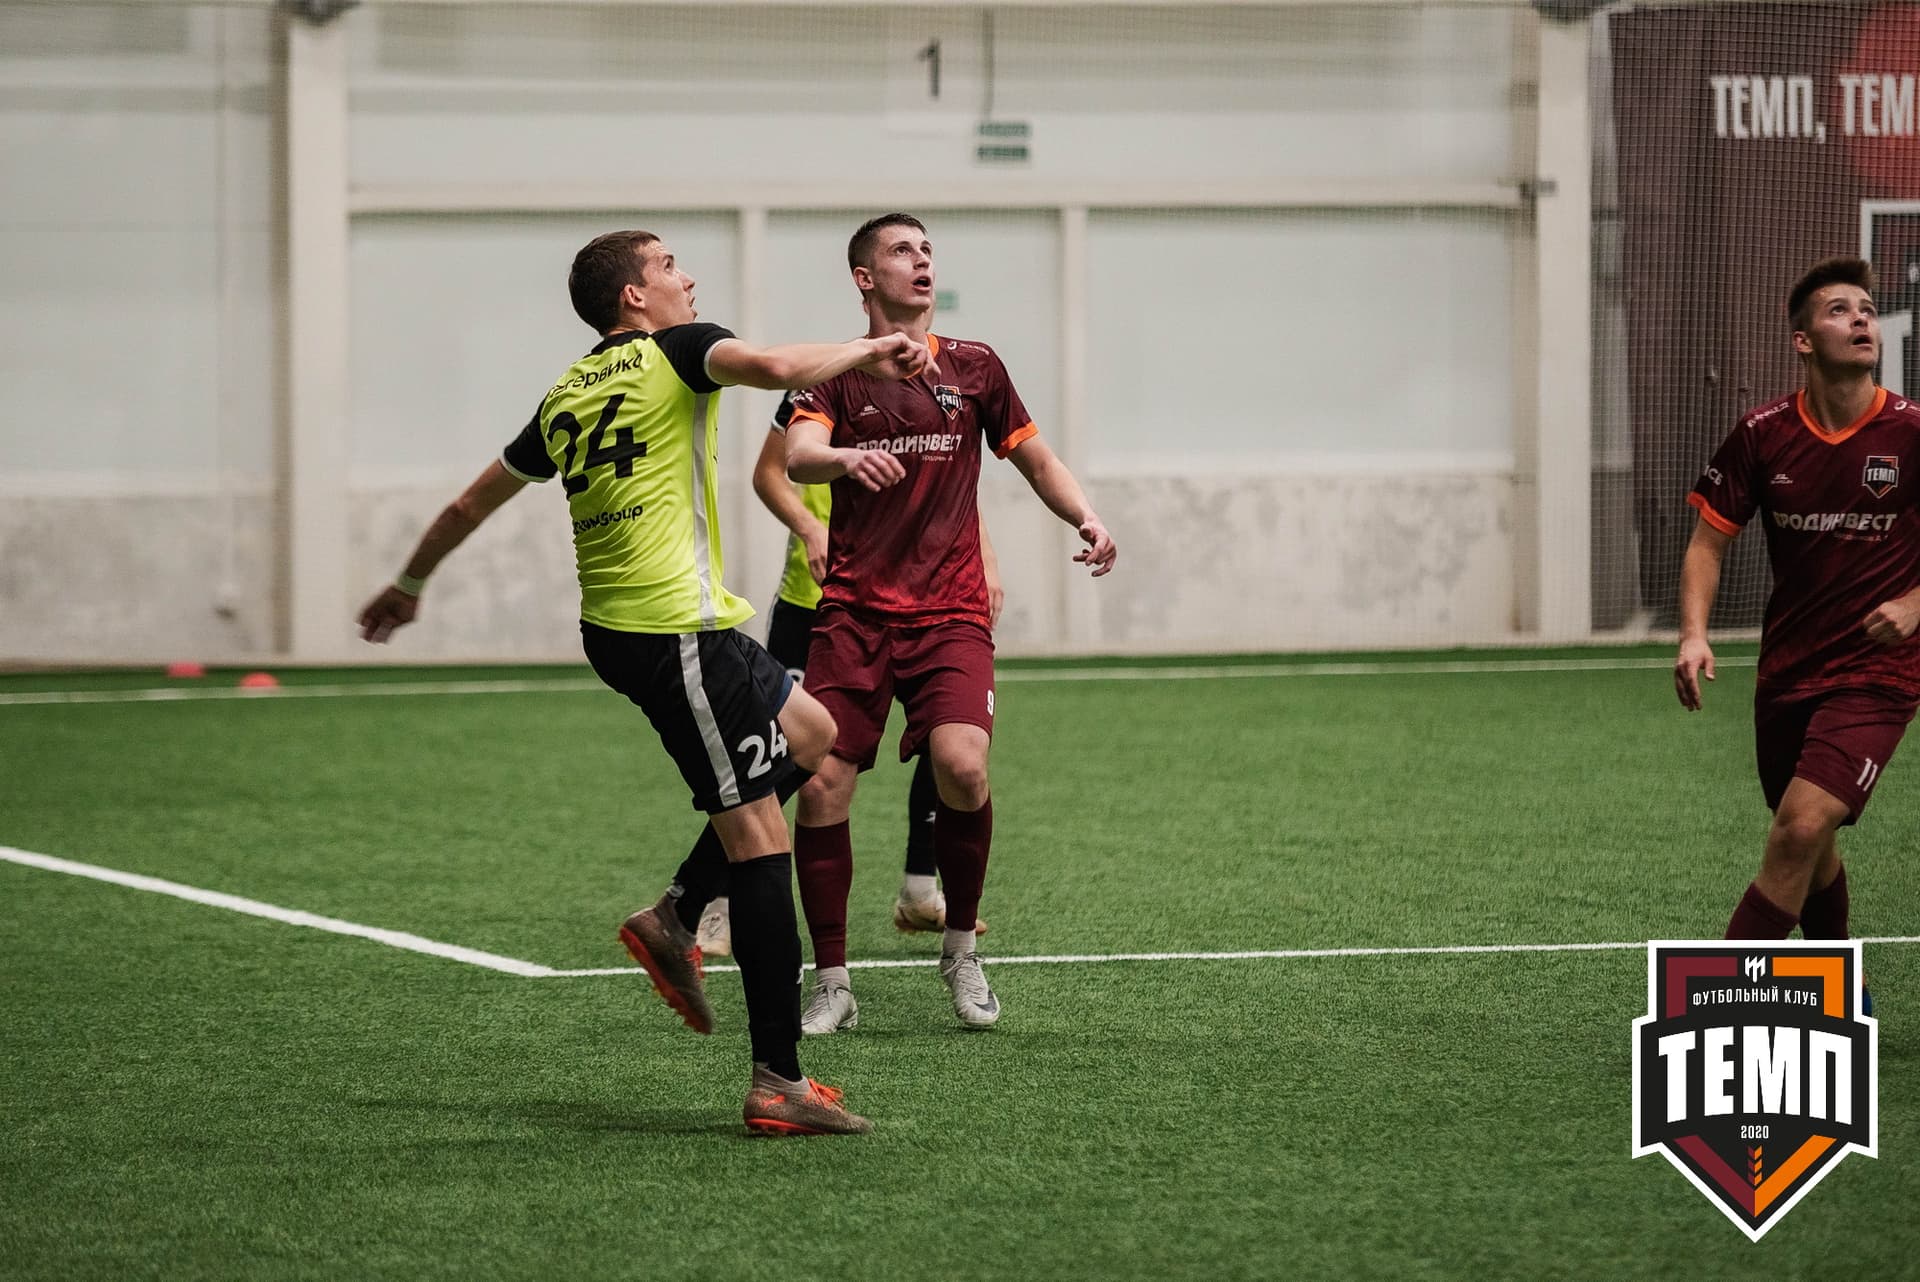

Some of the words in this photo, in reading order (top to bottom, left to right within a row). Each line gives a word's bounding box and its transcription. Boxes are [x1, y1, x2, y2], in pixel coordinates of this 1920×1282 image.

[916, 40, 940, 98] 1
[1711, 73, 1826, 144] ТЕМП,
[1839, 73, 1920, 137] ТЕМ
[548, 393, 648, 501] 24
[1867, 467, 1895, 482] ТЕМП
[987, 689, 994, 716] 9
[737, 719, 788, 780] 24
[1856, 757, 1879, 792] 11
